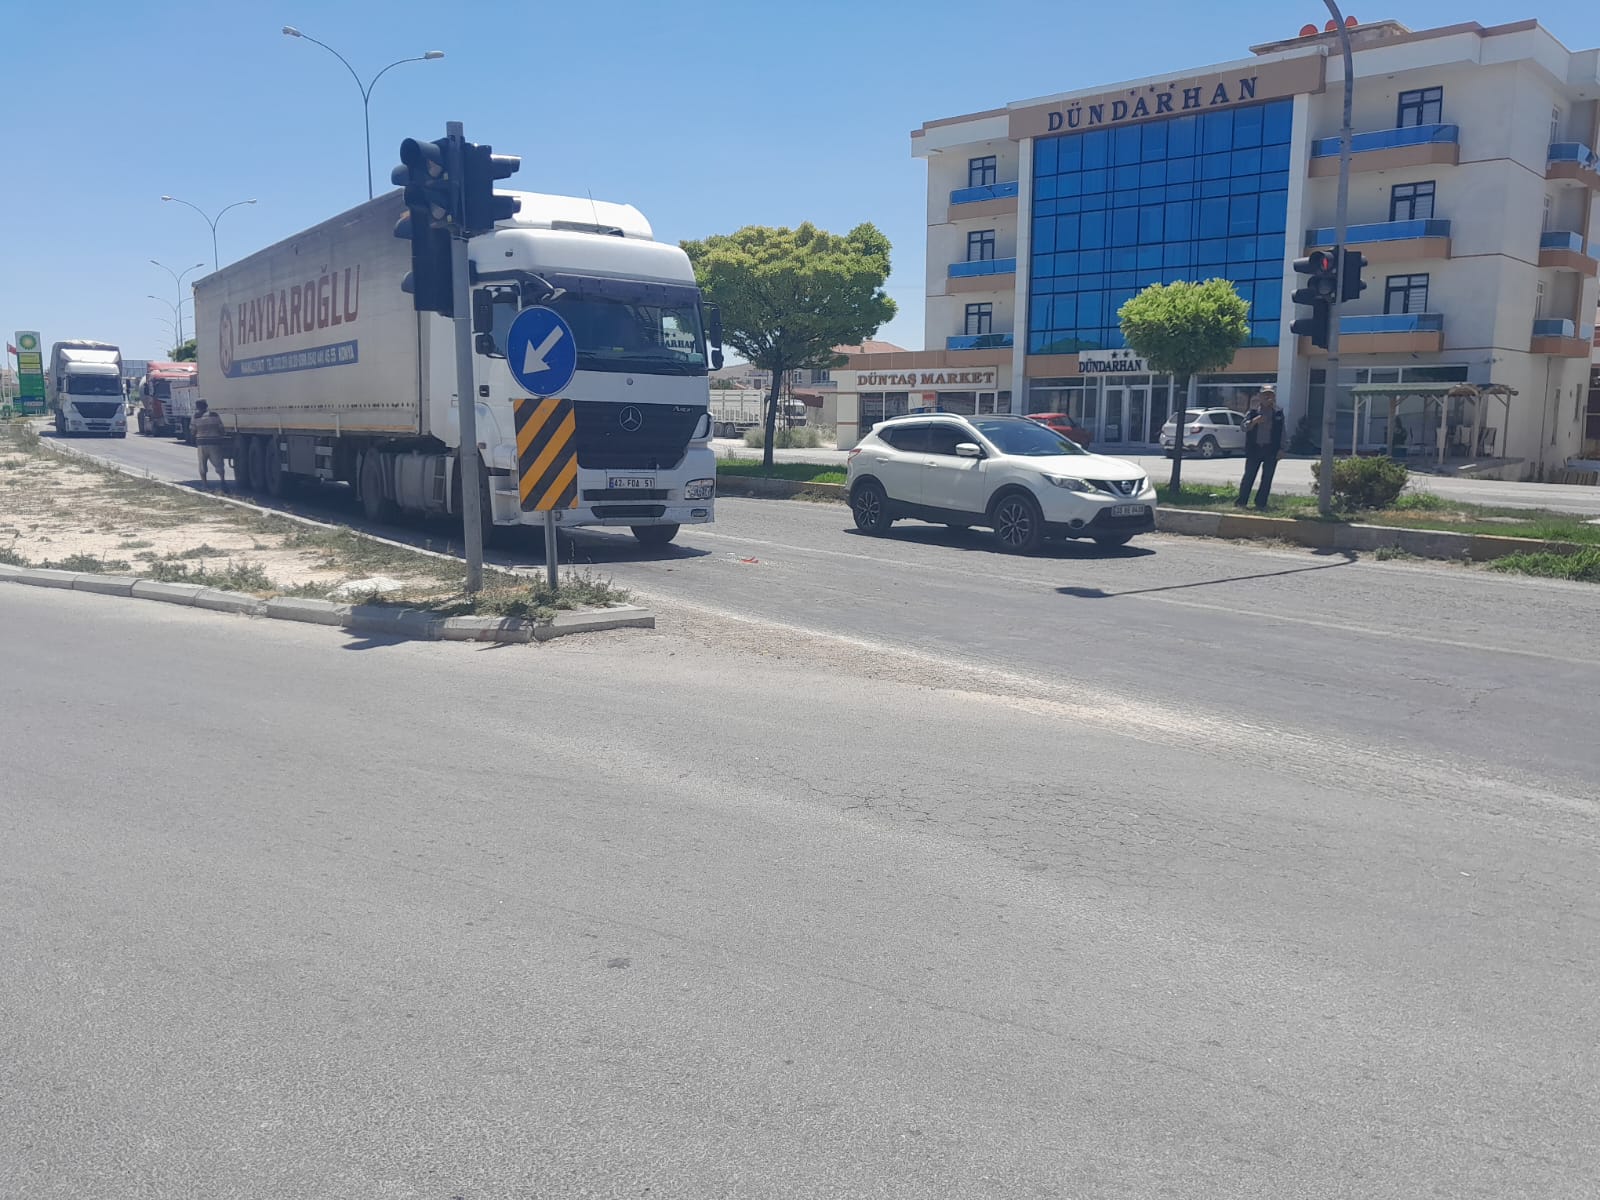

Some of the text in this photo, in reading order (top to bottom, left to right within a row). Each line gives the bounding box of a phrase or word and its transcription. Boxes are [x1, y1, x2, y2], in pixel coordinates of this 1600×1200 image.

[1047, 76, 1259, 132] DÜNDARHAN
[238, 263, 361, 346] HAYDAROĞLU
[857, 371, 995, 388] DÜNTAŞ MARKET
[1078, 357, 1142, 373] DÜNDARHAN
